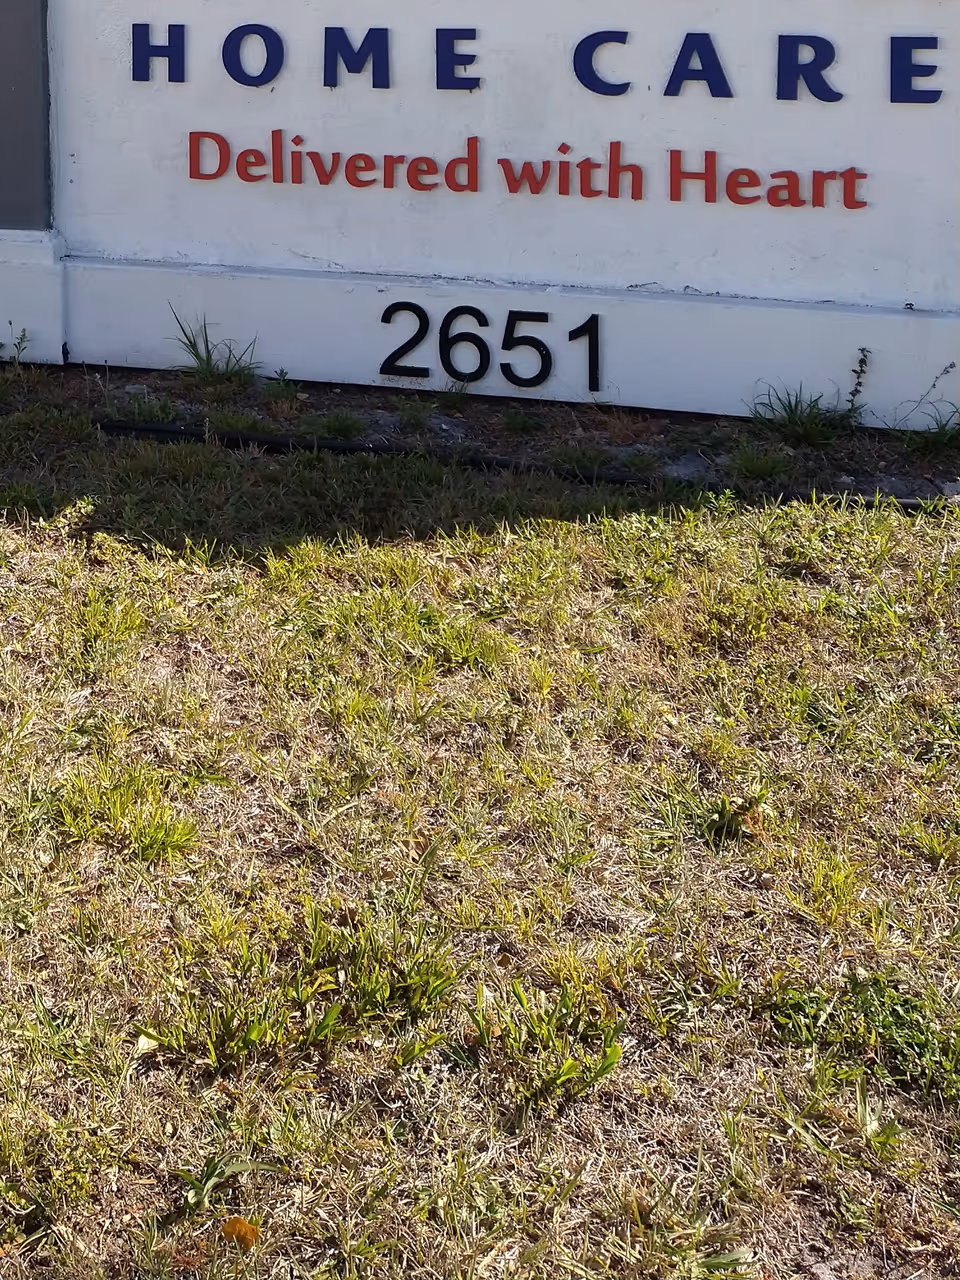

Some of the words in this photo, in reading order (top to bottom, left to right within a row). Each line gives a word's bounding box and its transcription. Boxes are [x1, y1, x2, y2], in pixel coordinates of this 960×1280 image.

[132, 24, 481, 92] HOME
[573, 31, 943, 103] CARE
[188, 130, 479, 193] Delivered
[498, 142, 643, 201] with
[669, 150, 869, 210] Heart
[380, 302, 600, 392] 2651
